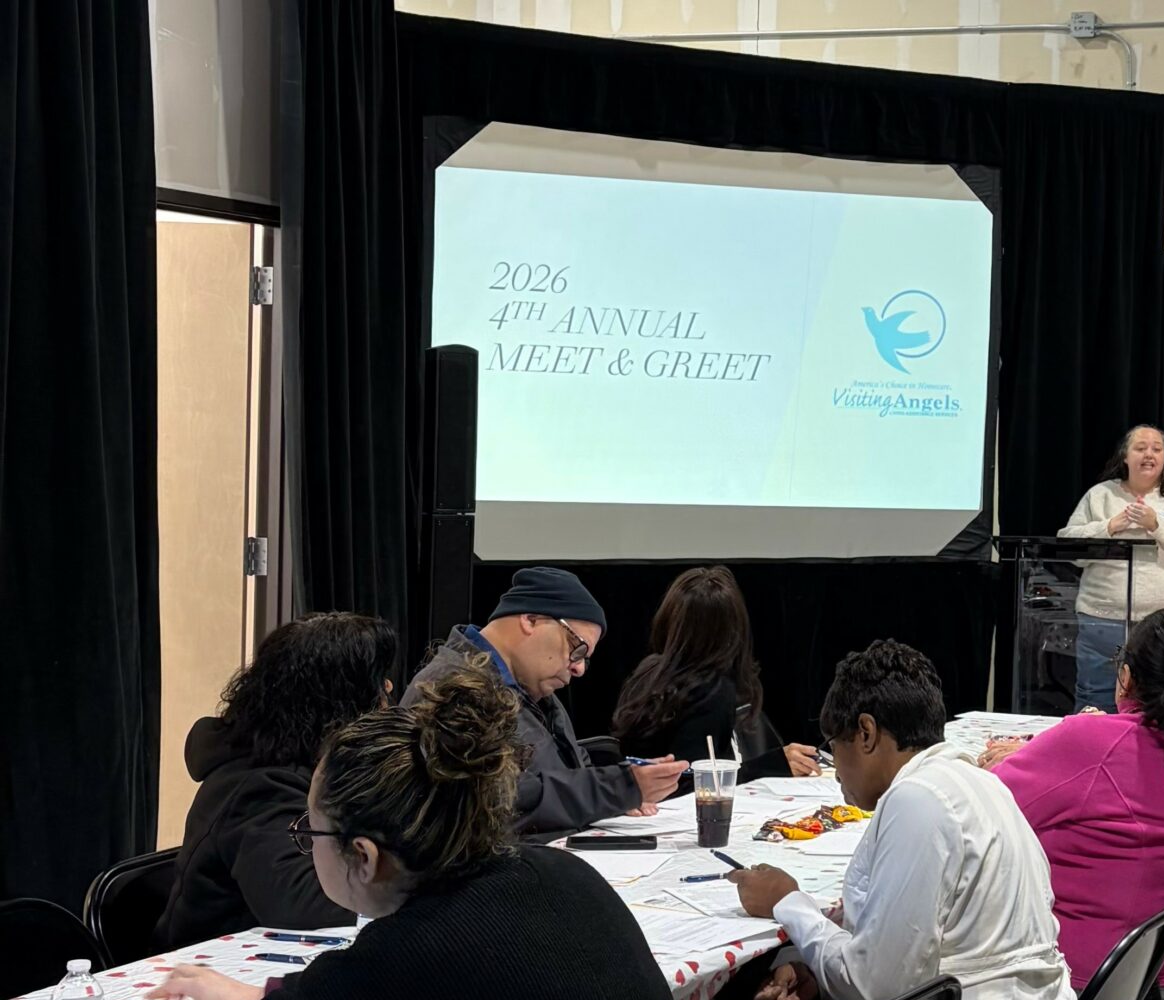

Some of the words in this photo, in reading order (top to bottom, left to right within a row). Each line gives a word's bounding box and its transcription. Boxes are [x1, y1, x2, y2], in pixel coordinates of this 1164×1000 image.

[489, 261, 571, 294] 2026
[488, 300, 548, 331] 4TH
[548, 305, 707, 340] ANNUAL
[485, 342, 605, 376] MEET
[607, 347, 635, 377] &
[643, 349, 772, 382] GREET
[832, 386, 894, 418] Visiting
[893, 393, 960, 412] Angels
